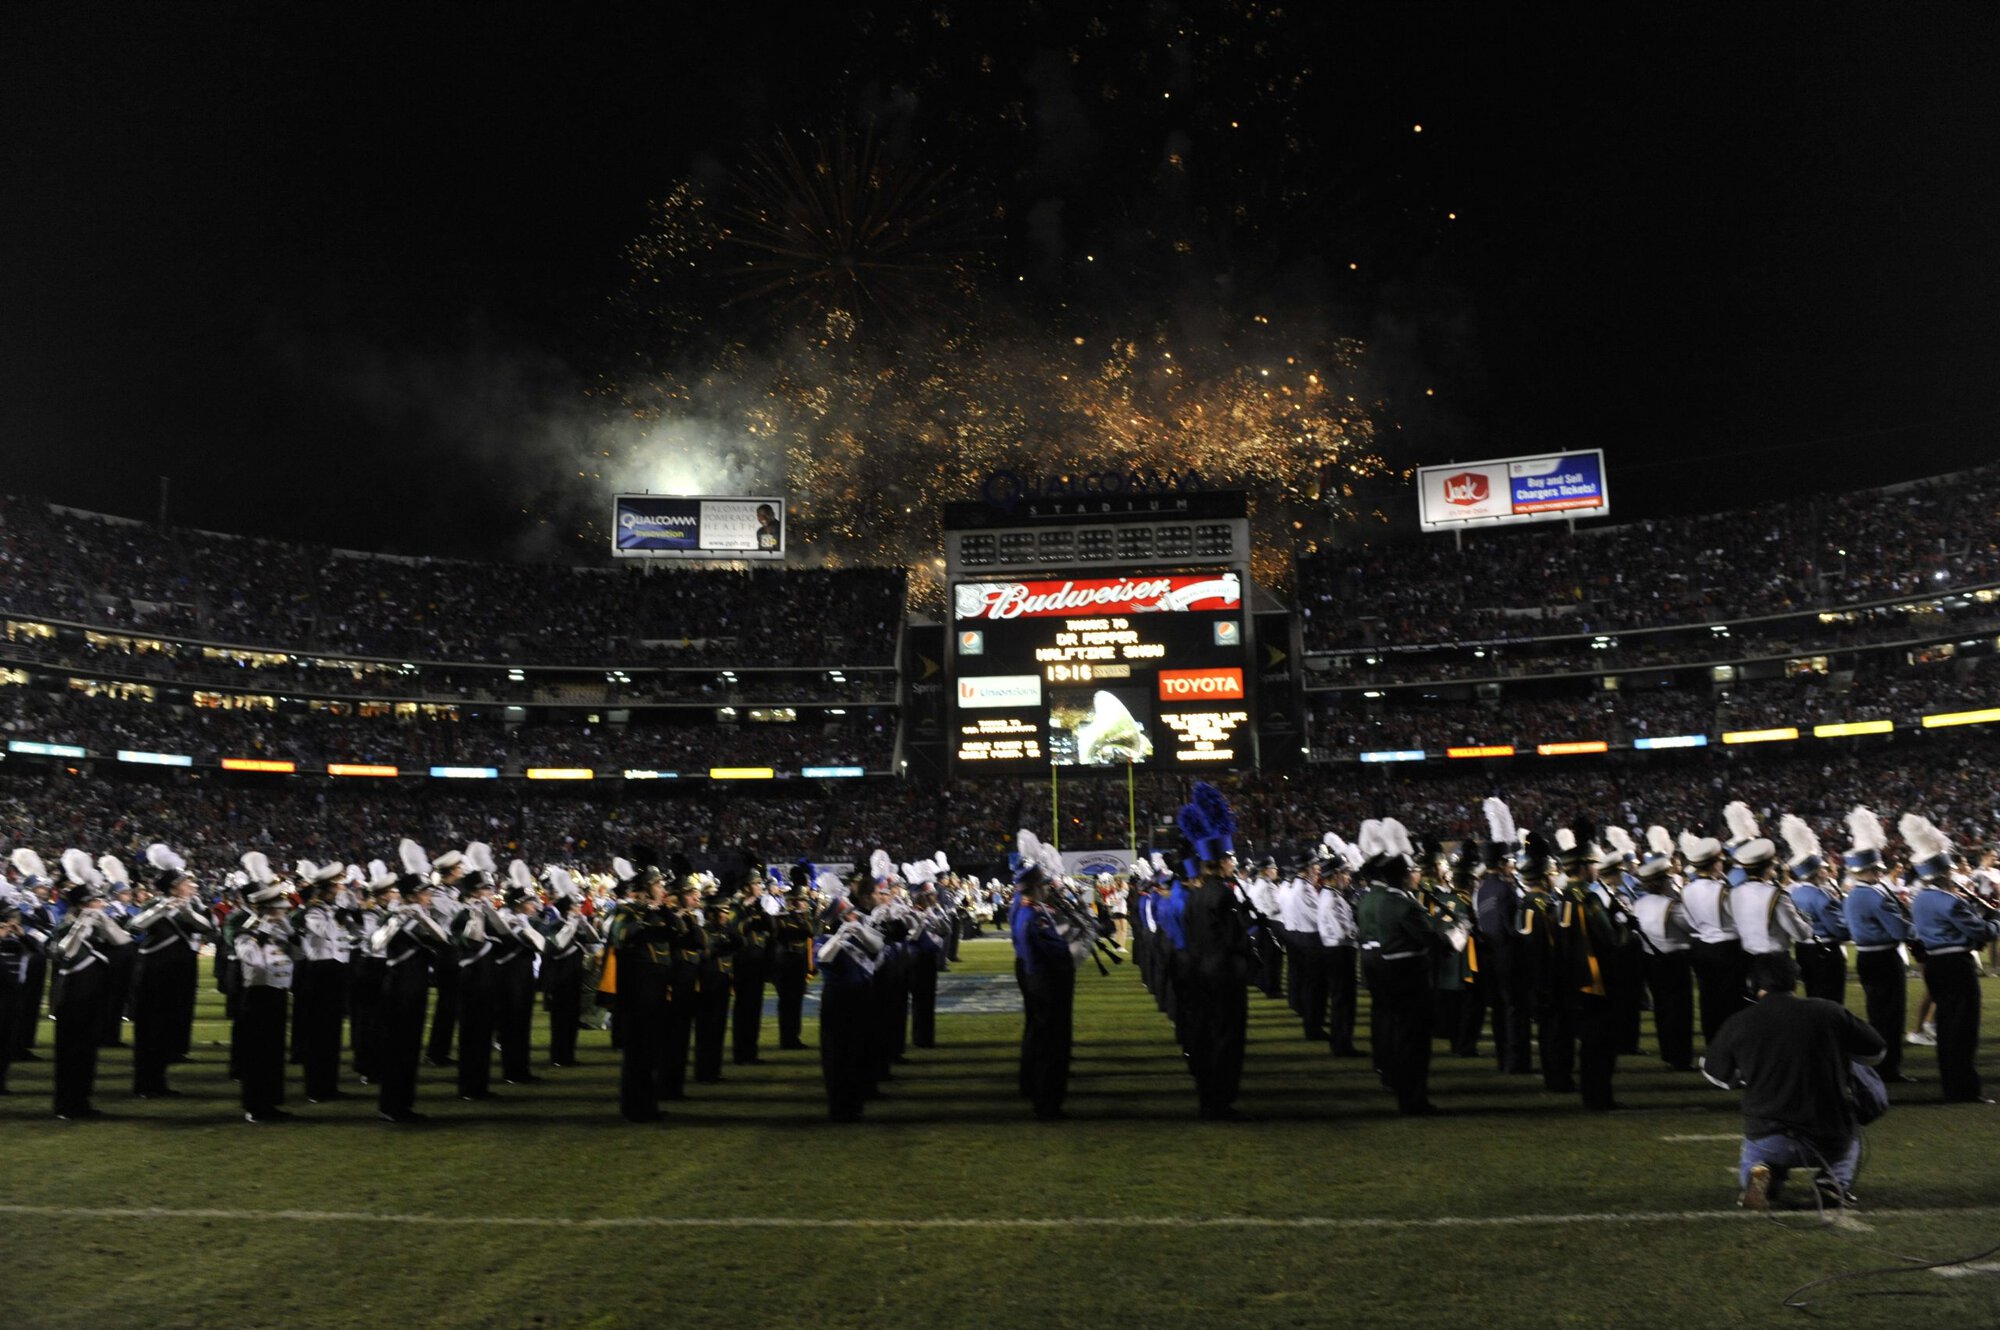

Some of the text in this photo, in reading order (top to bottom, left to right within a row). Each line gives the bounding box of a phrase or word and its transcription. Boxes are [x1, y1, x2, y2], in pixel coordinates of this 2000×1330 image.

[1527, 472, 1583, 488] Buy and Sell
[1516, 488, 1559, 500] Chargers
[703, 504, 755, 513] PALOMAR
[1028, 499, 1188, 516] STADIUM
[621, 514, 696, 529] QUALCOMM
[704, 522, 755, 530] HEALTH
[983, 578, 1171, 619] Budweiser
[1065, 618, 1128, 631] THANKS TO
[1056, 631, 1138, 646] DR PEPPER
[1036, 644, 1165, 661] HALFTIME SHOW
[1162, 677, 1240, 693] TOYOTA
